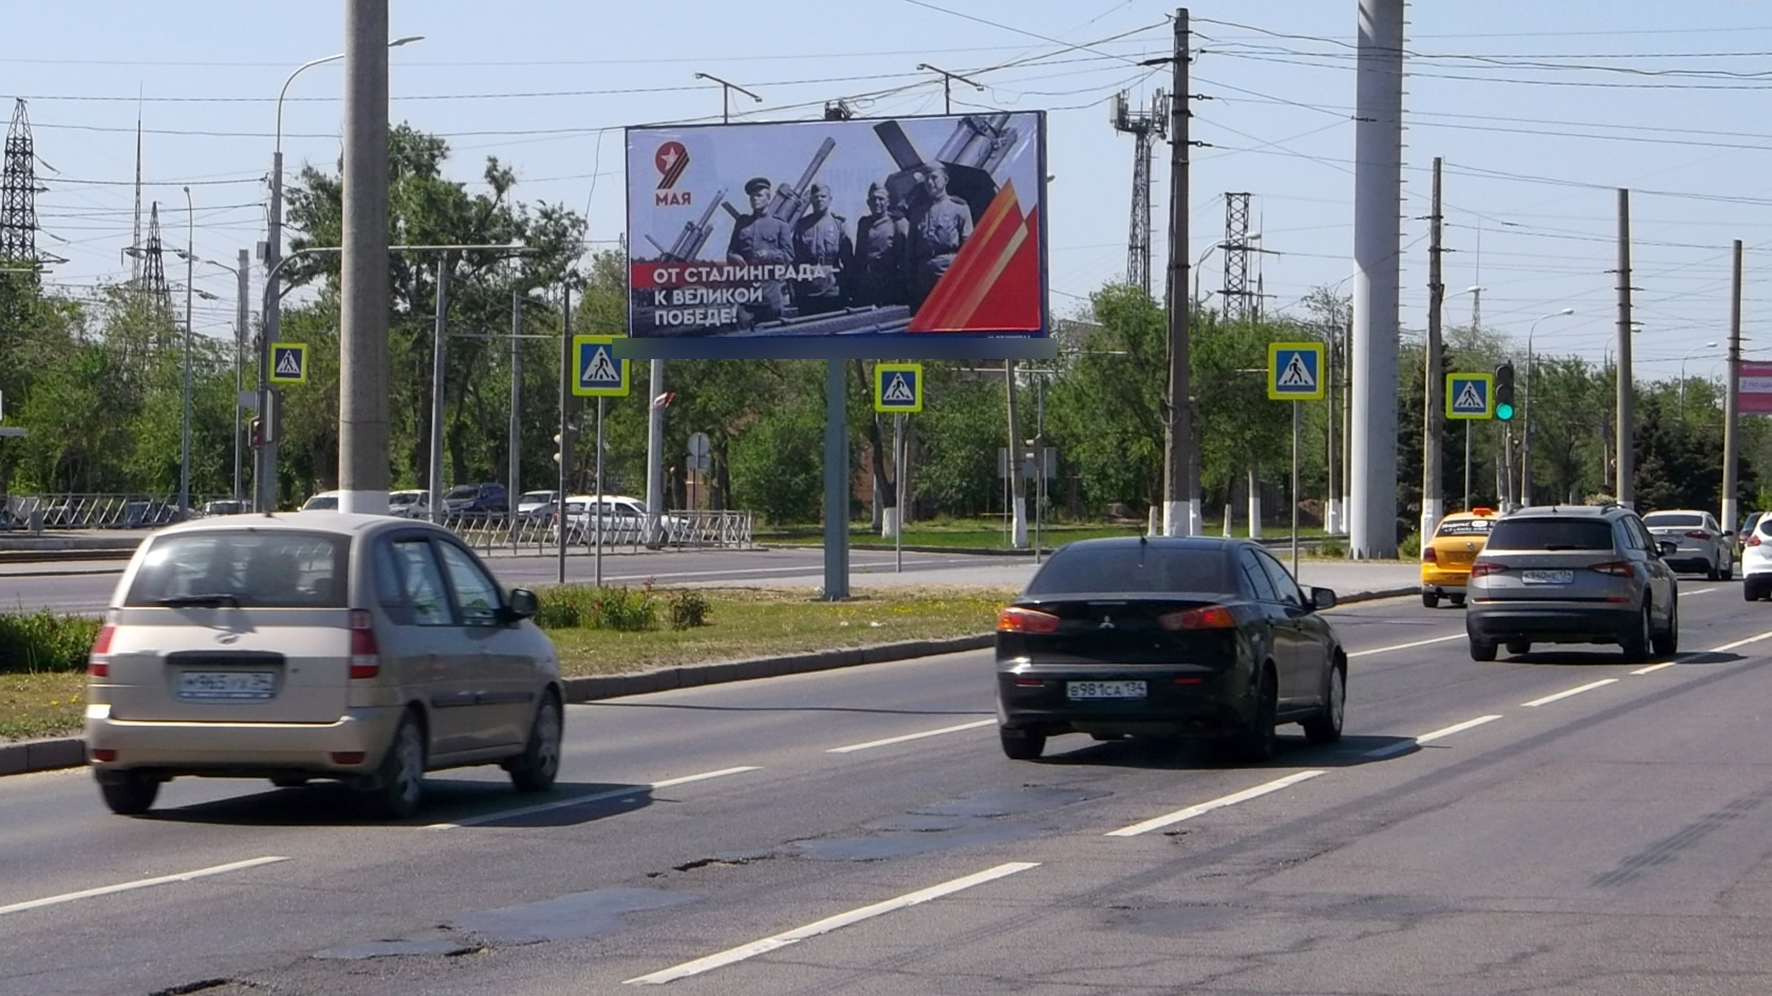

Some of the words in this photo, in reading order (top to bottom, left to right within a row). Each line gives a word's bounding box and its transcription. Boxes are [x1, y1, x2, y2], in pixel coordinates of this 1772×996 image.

[655, 141, 690, 190] 9
[655, 192, 691, 206] МАЯ
[653, 268, 680, 283] ОТ
[684, 264, 826, 283] СТАЛИНГРАДА
[654, 290, 667, 306] К
[673, 282, 763, 305] ВЕЛИКОЙ
[655, 309, 738, 327] ПОБЕДЕ!
